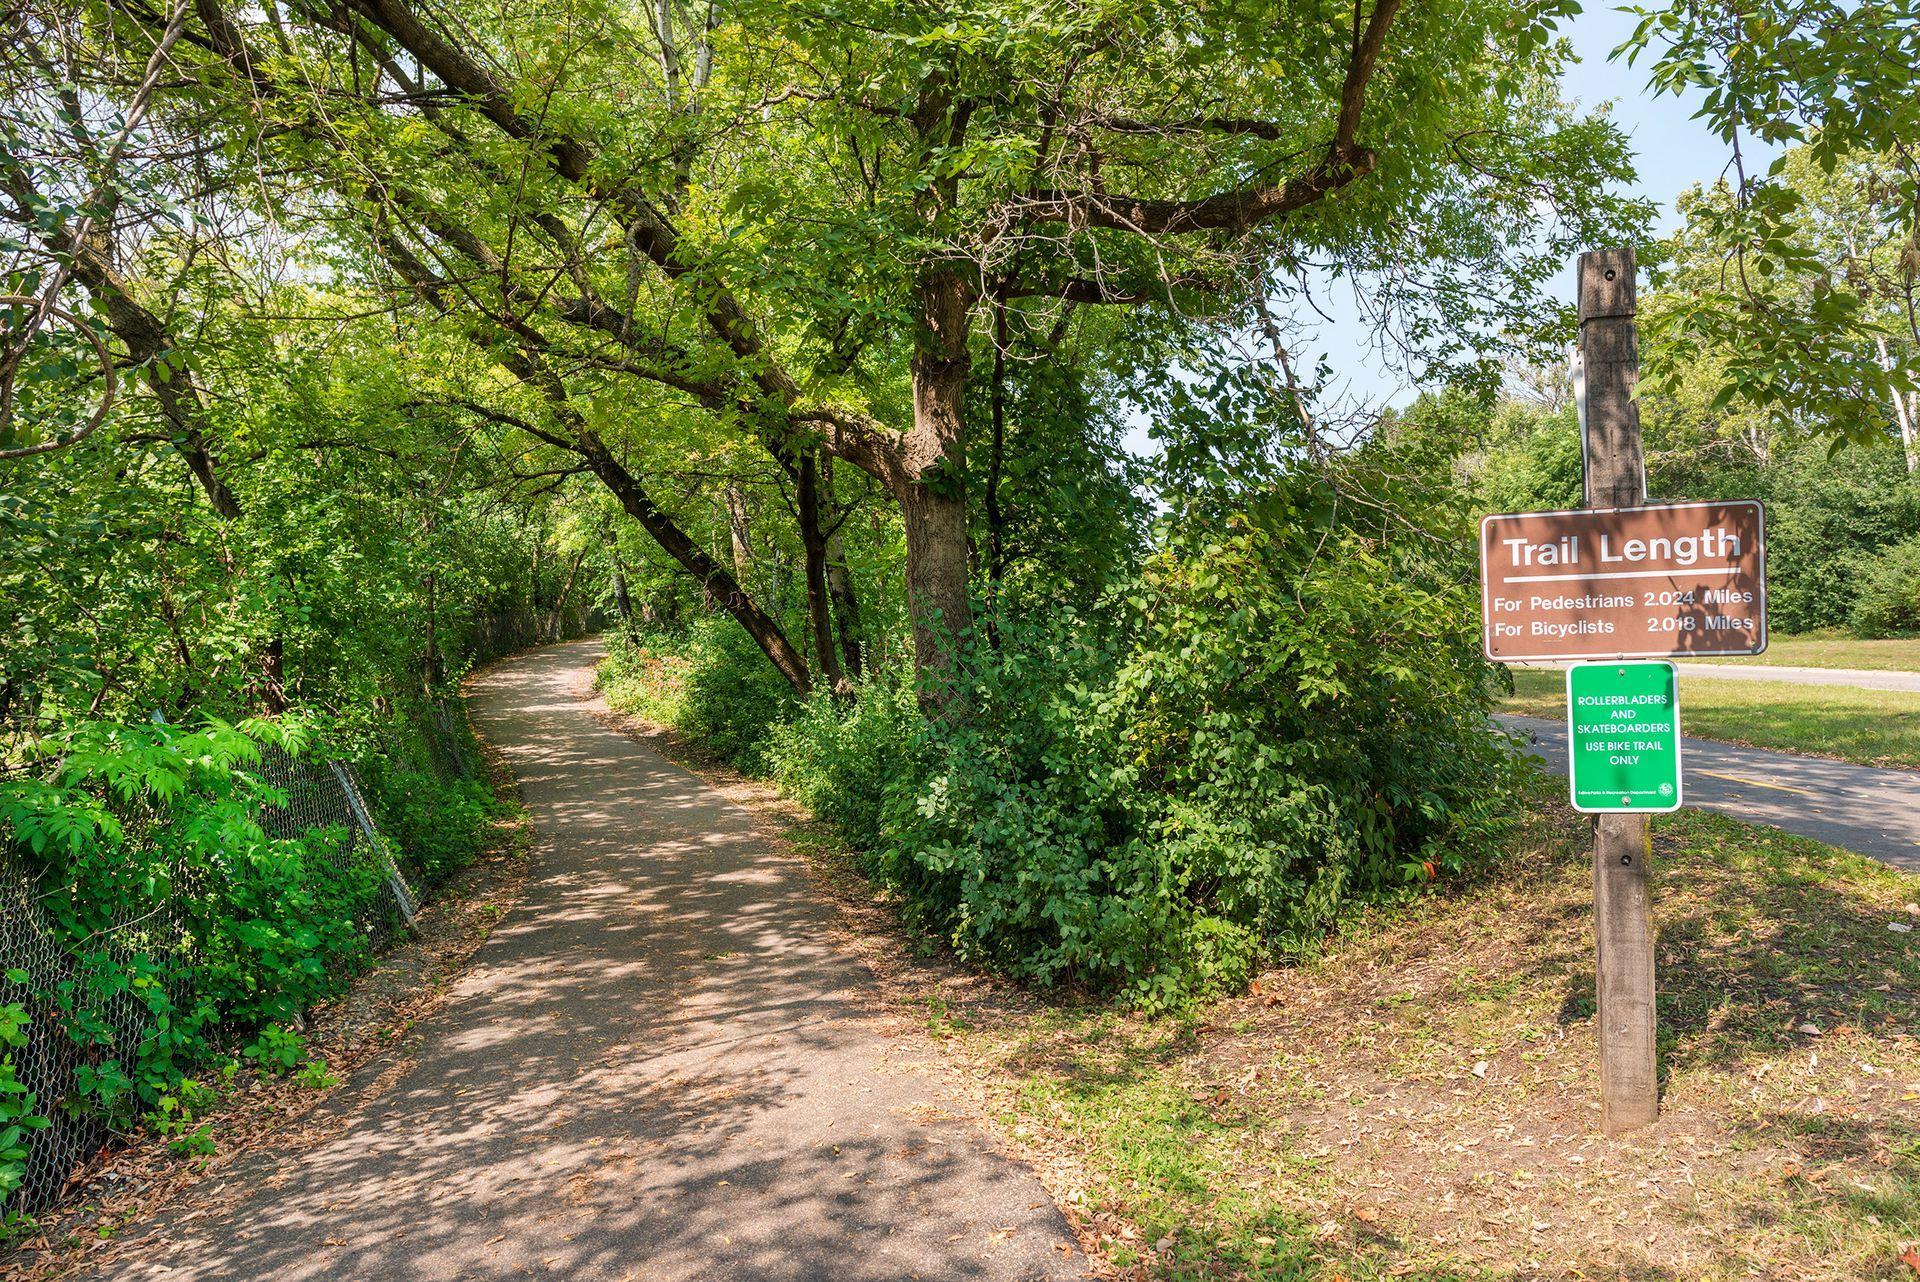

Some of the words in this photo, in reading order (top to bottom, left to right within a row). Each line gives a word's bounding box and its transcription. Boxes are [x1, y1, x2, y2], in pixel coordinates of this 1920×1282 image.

[1503, 535, 1578, 567] Trail
[1600, 528, 1741, 565] Length
[1494, 597, 1522, 612] For
[1530, 593, 1634, 610] Pedestrians
[1644, 590, 1695, 606] 2.024
[1704, 588, 1753, 604] Miles
[1495, 622, 1523, 637] For
[1531, 619, 1615, 638] Bicyclists
[1647, 616, 1696, 632] 2.018
[1705, 614, 1754, 630] Miles
[1578, 695, 1667, 705] ROLLERBLADERS
[1610, 709, 1636, 719] AND
[1577, 724, 1670, 733] SKATEBOARDERS
[1585, 741, 1605, 751] USE
[1607, 741, 1630, 751] BIKE
[1633, 741, 1663, 751] TRAIL
[1609, 756, 1639, 765] ONLY
